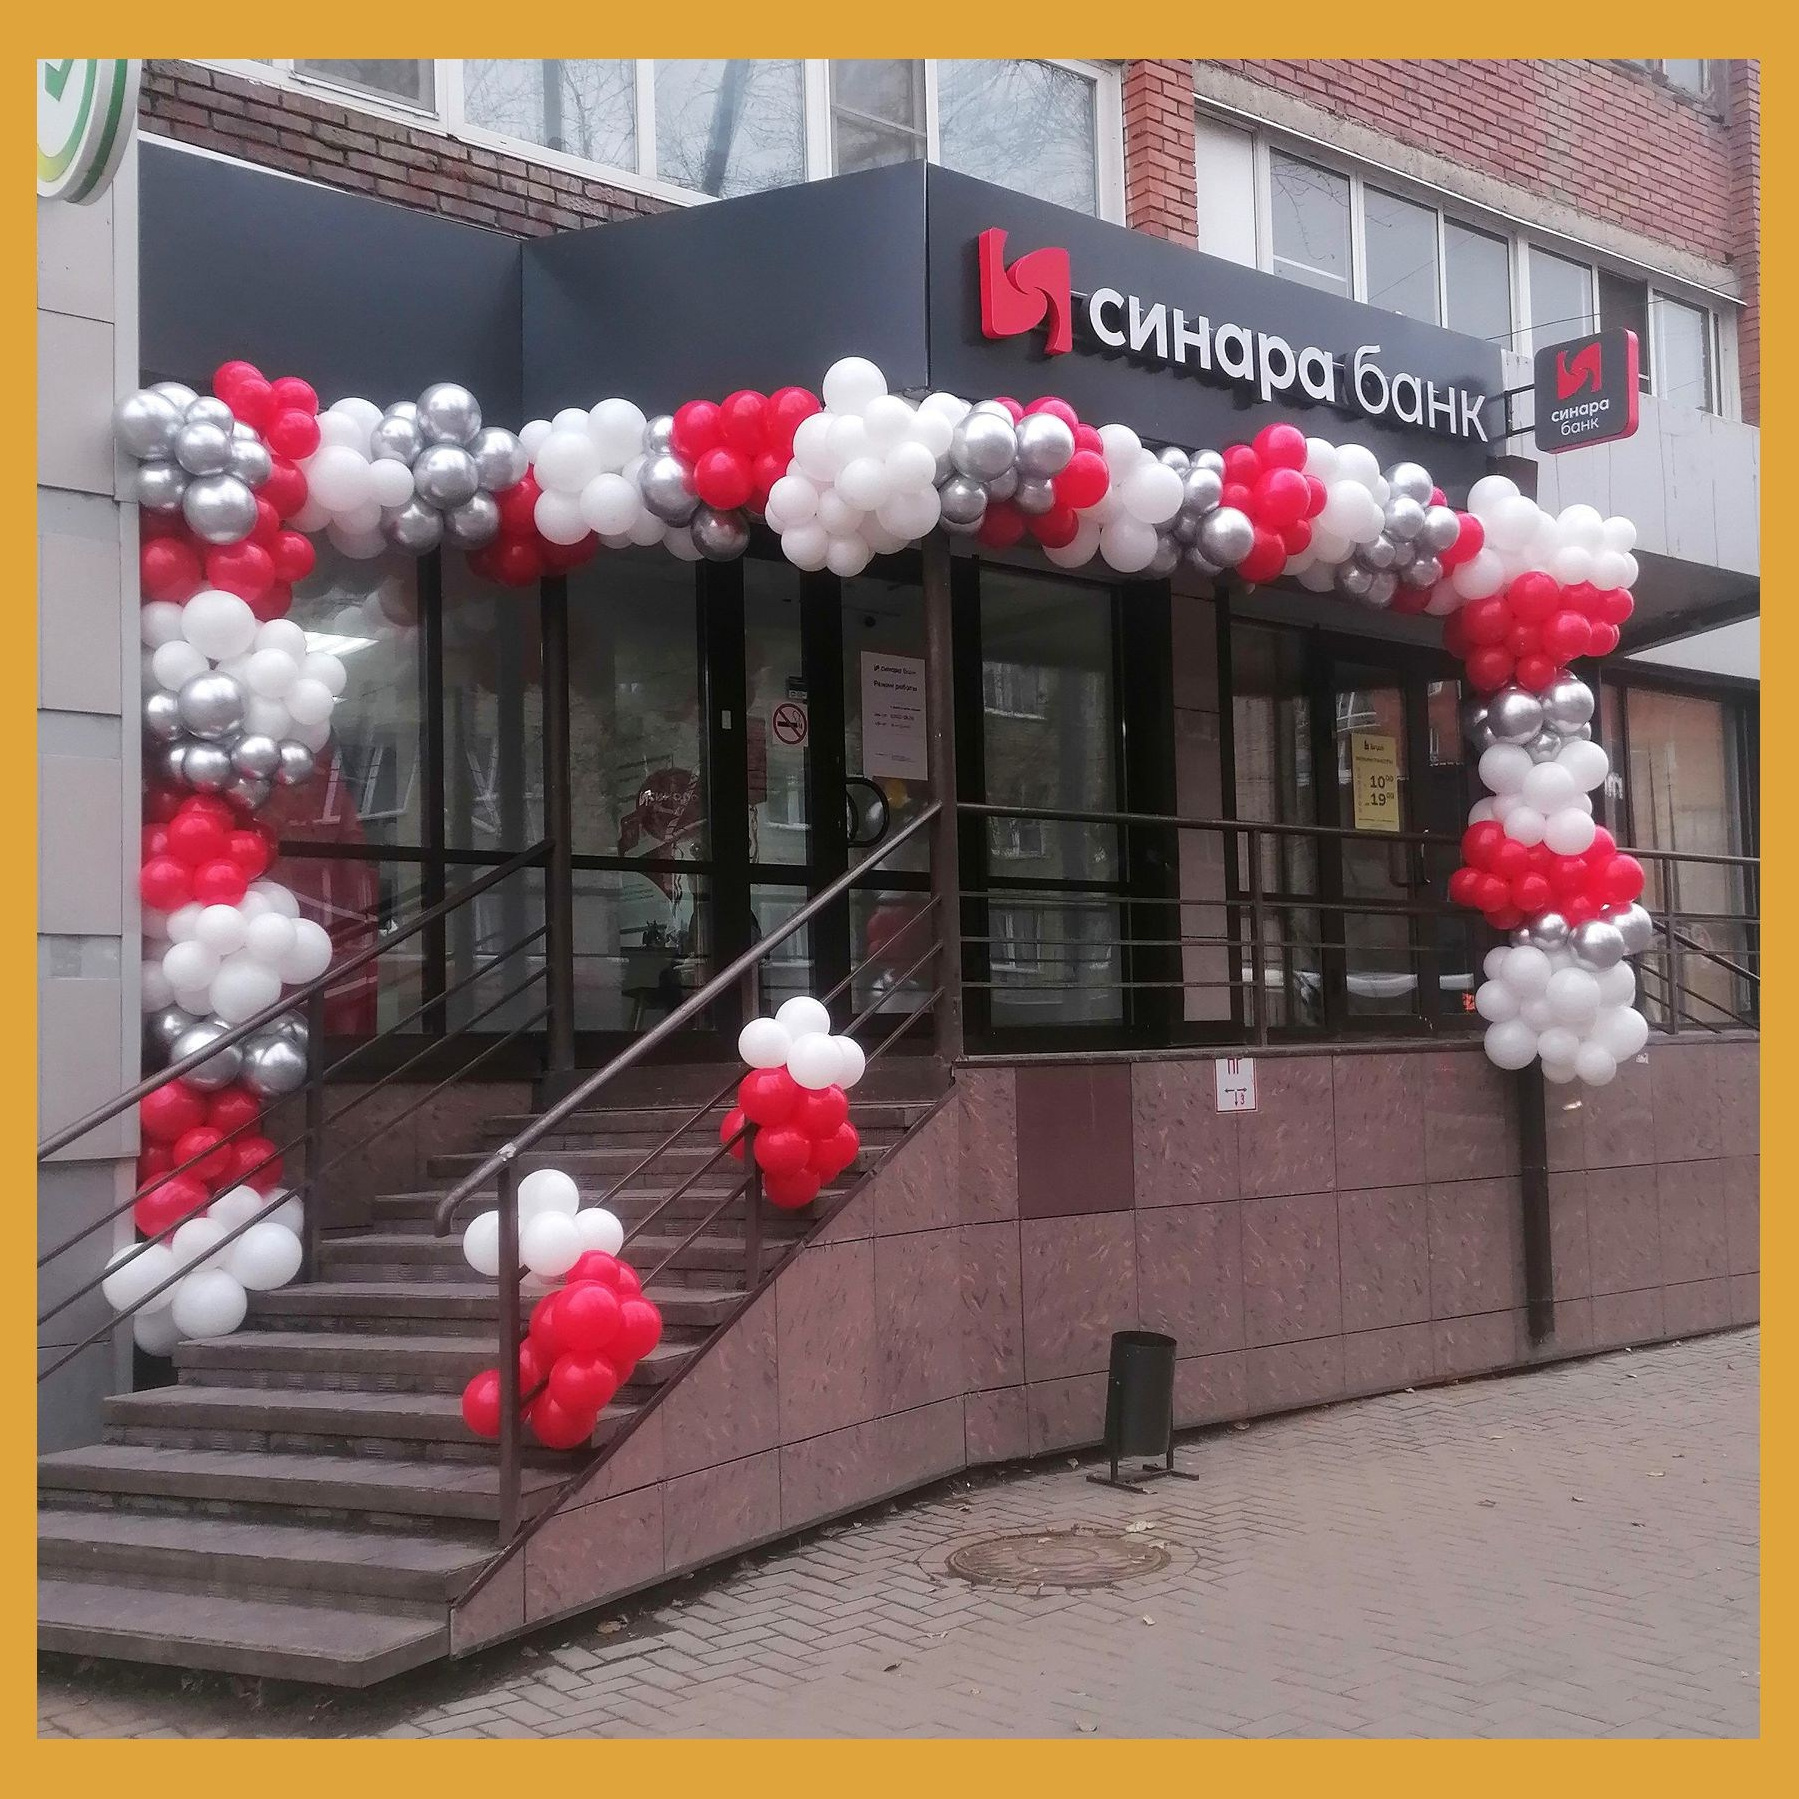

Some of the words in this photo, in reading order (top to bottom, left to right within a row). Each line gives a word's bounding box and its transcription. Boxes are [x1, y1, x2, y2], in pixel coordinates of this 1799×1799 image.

[1089, 287, 1336, 402] синара
[1353, 344, 1489, 443] банк
[1551, 398, 1610, 423] синара
[1560, 417, 1600, 436] банк
